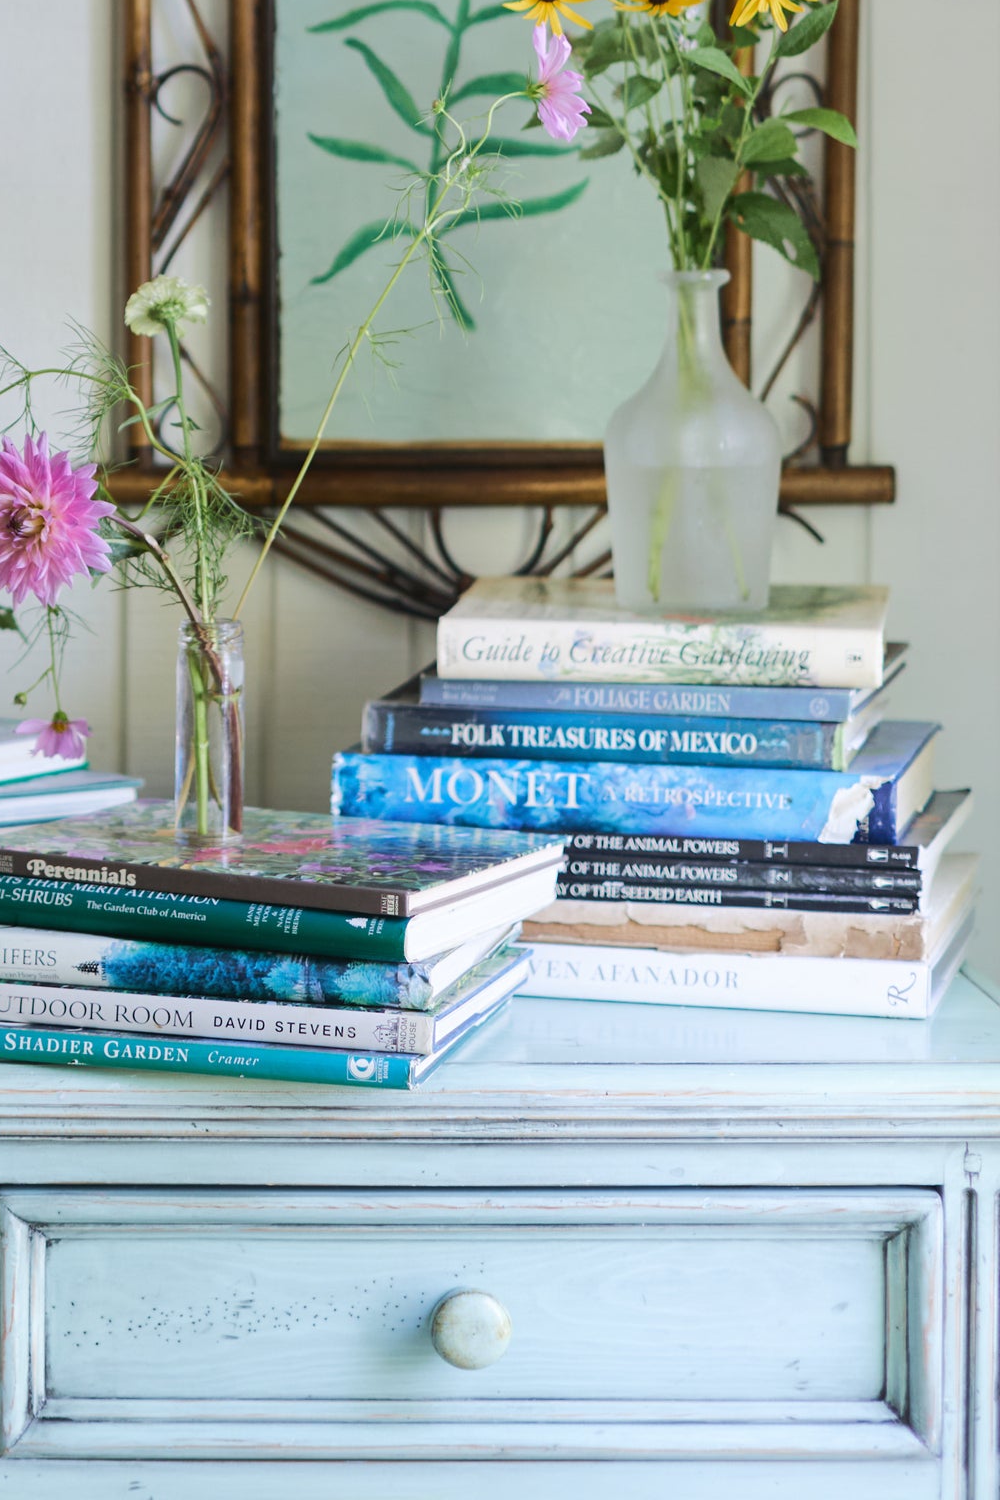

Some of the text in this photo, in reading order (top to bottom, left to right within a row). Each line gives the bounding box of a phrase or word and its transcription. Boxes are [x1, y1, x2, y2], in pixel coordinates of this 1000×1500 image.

[463, 634, 534, 661] Guide
[541, 641, 560, 662] to
[569, 636, 673, 664] Creative
[679, 639, 811, 674] Gardening
[574, 687, 650, 709] FOLIAGE
[653, 691, 731, 712] GARDEN
[450, 723, 757, 755] FOLK TREASURES OF MEXICO
[405, 767, 791, 810] MONET A RETROSPECTIVE
[574, 835, 592, 849] OF
[593, 836, 624, 850] THE
[625, 837, 682, 853] ANIMAL
[683, 840, 740, 855] POWERS
[26, 859, 137, 887] Perennials
[571, 861, 591, 875] OF
[592, 862, 621, 877] THE
[622, 864, 680, 879] ANIMAL
[681, 866, 738, 882] POWERS
[26, 877, 68, 890] THAT
[72, 883, 124, 895] MERIT
[570, 883, 591, 897] OF
[592, 884, 620, 898] THE
[621, 886, 675, 901] SEEDED
[676, 888, 722, 904] EARTH
[86, 900, 207, 922] The Garden Club of America
[277, 907, 287, 928] NANC
[528, 959, 739, 989] VEN AFANADOR
[114, 1004, 194, 1029] ROOM
[213, 1015, 357, 1039] DAVID STEVENS
[4, 1032, 94, 1056] SHADIER
[104, 1039, 189, 1062] GARDEN
[400, 1017, 408, 1053] RANDOM
[408, 1021, 417, 1051] HOUSE
[207, 1050, 260, 1067] Cramer
